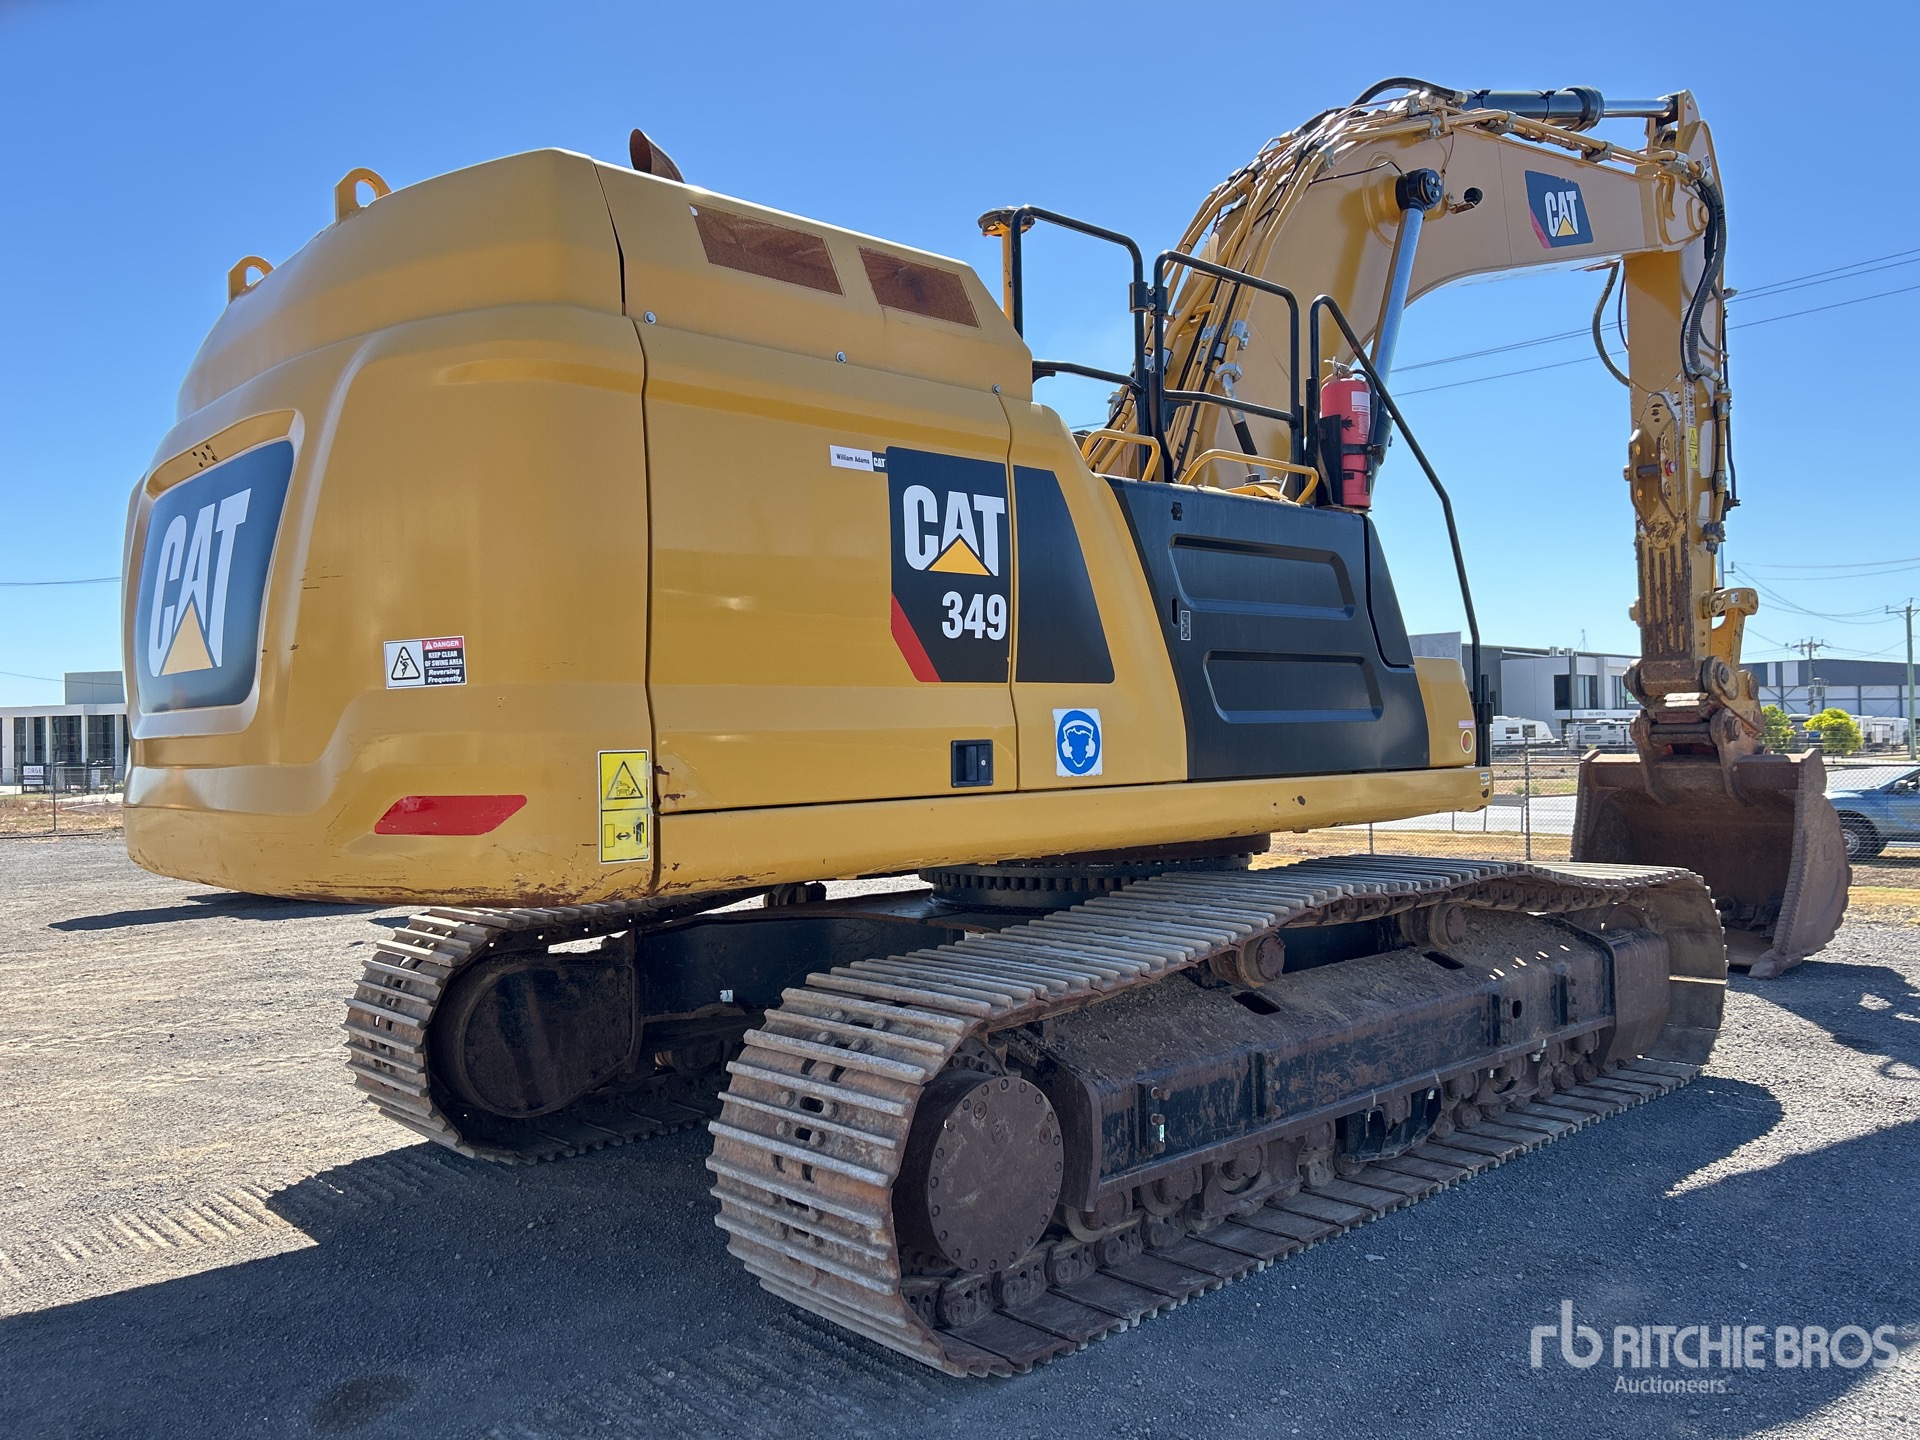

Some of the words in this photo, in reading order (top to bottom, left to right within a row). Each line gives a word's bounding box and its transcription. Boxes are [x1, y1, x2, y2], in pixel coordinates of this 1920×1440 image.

[1545, 191, 1578, 237] CAT
[836, 453, 853, 462] William
[855, 456, 870, 465] Adams
[874, 457, 886, 468] CAT
[903, 485, 1005, 576] CAT
[148, 488, 251, 677] CAT
[941, 591, 1007, 640] 349
[433, 640, 459, 648] DANGER
[428, 668, 460, 676] Reversing
[428, 675, 462, 683] Frequently
